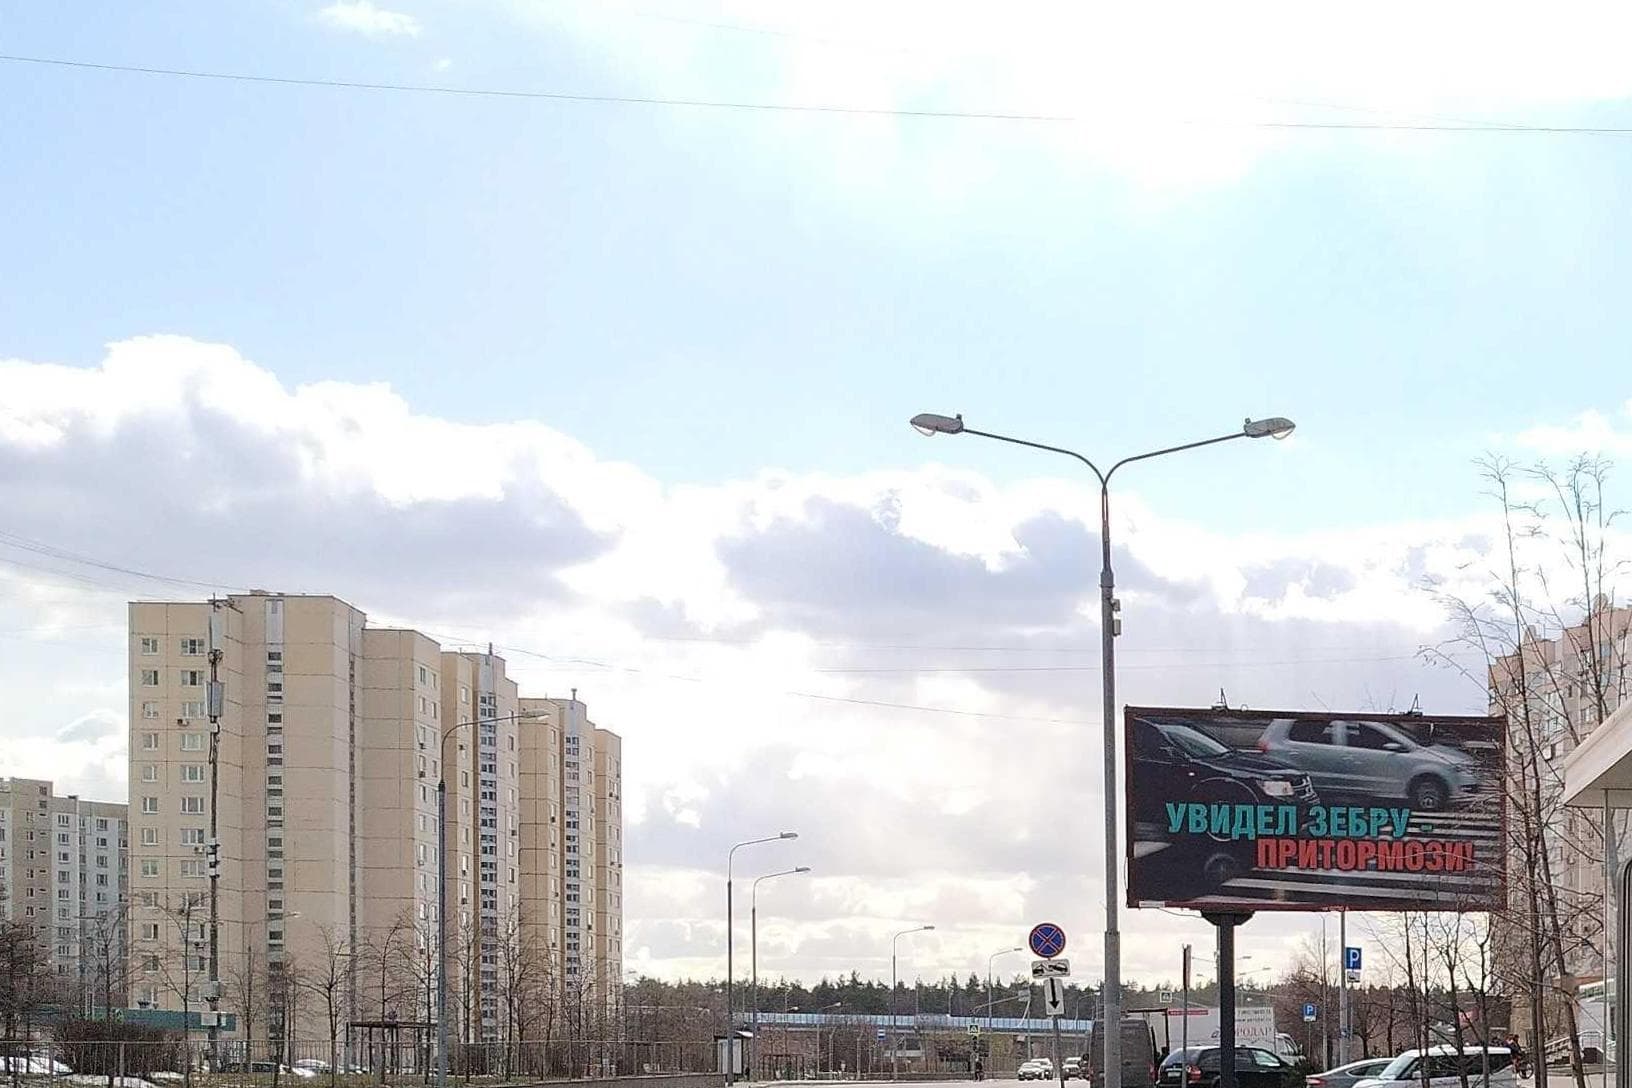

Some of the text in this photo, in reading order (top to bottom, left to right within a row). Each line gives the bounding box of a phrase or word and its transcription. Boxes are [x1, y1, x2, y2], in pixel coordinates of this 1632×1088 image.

[1166, 802, 1298, 840] УВИДЕЛ
[1308, 806, 1410, 838] ЗЕБРУ
[1257, 838, 1475, 871] ПРИТОРМОЗИ!
